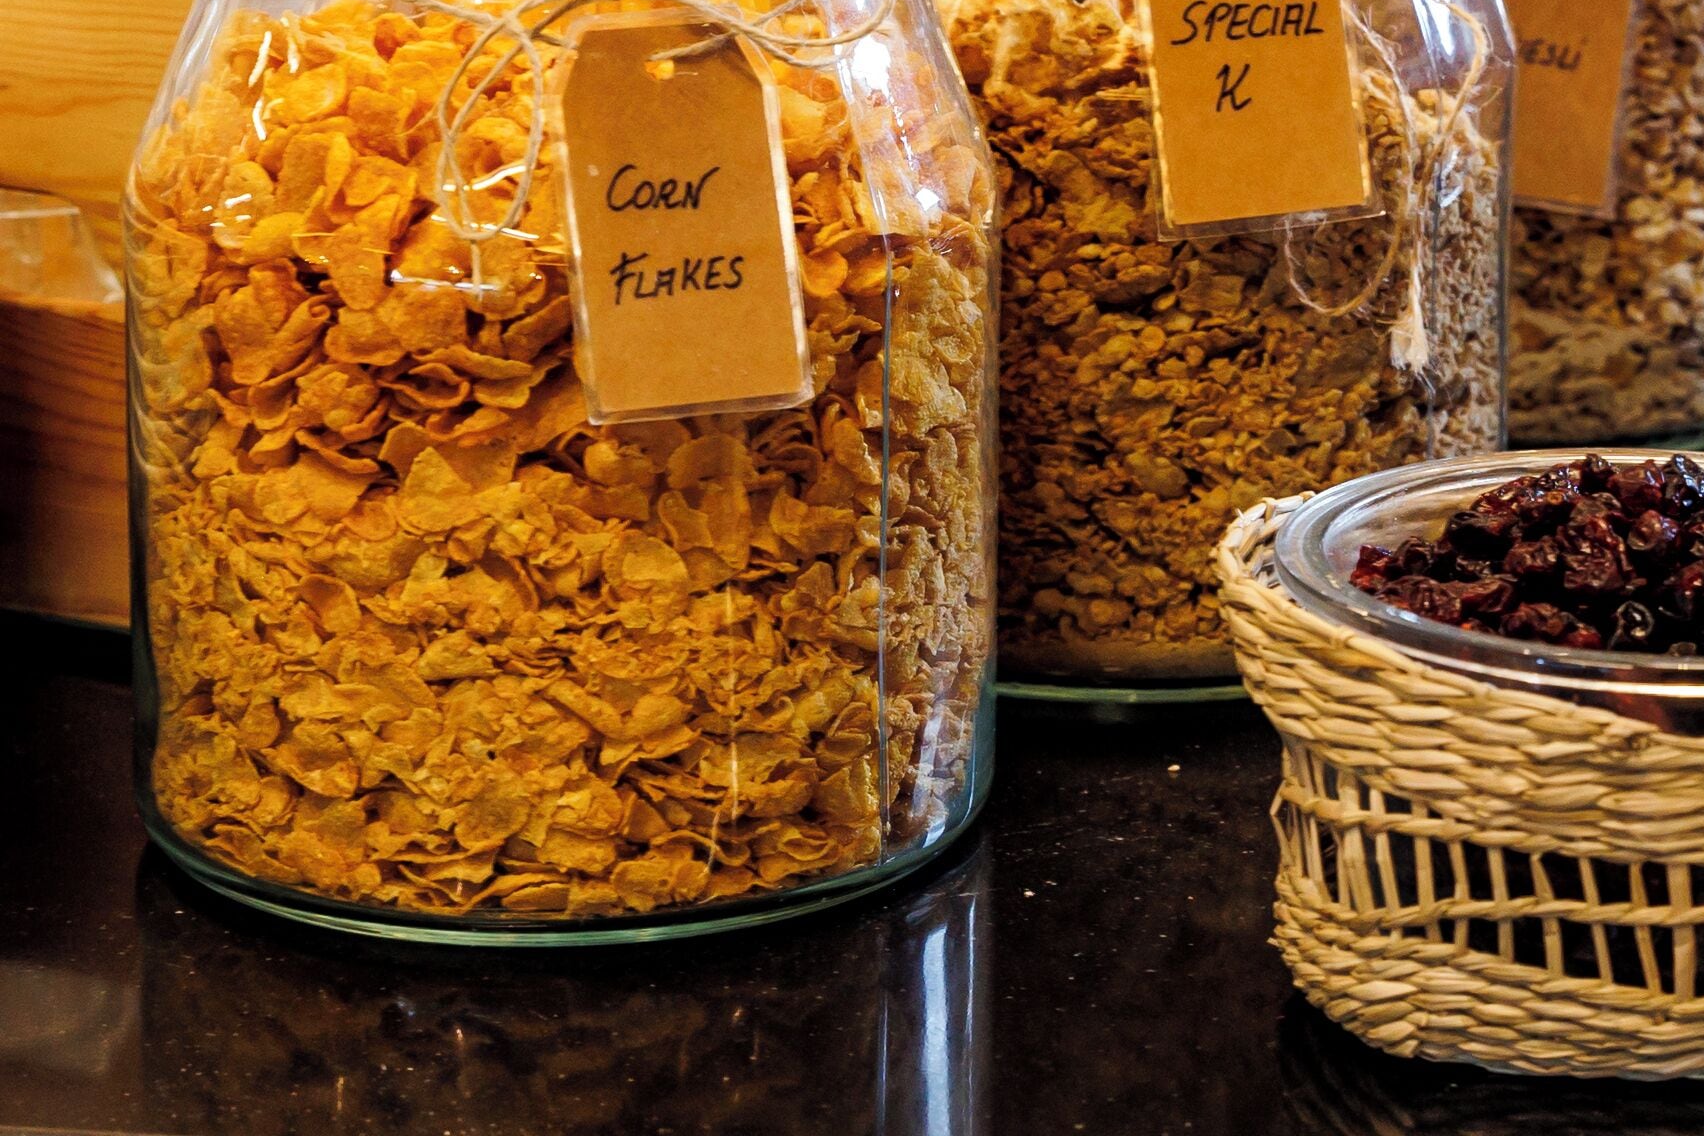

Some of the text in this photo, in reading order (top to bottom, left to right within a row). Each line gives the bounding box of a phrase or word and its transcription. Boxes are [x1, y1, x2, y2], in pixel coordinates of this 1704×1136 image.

[1215, 63, 1252, 112] K
[606, 164, 720, 212] CORN
[609, 252, 744, 304] FLAKES
